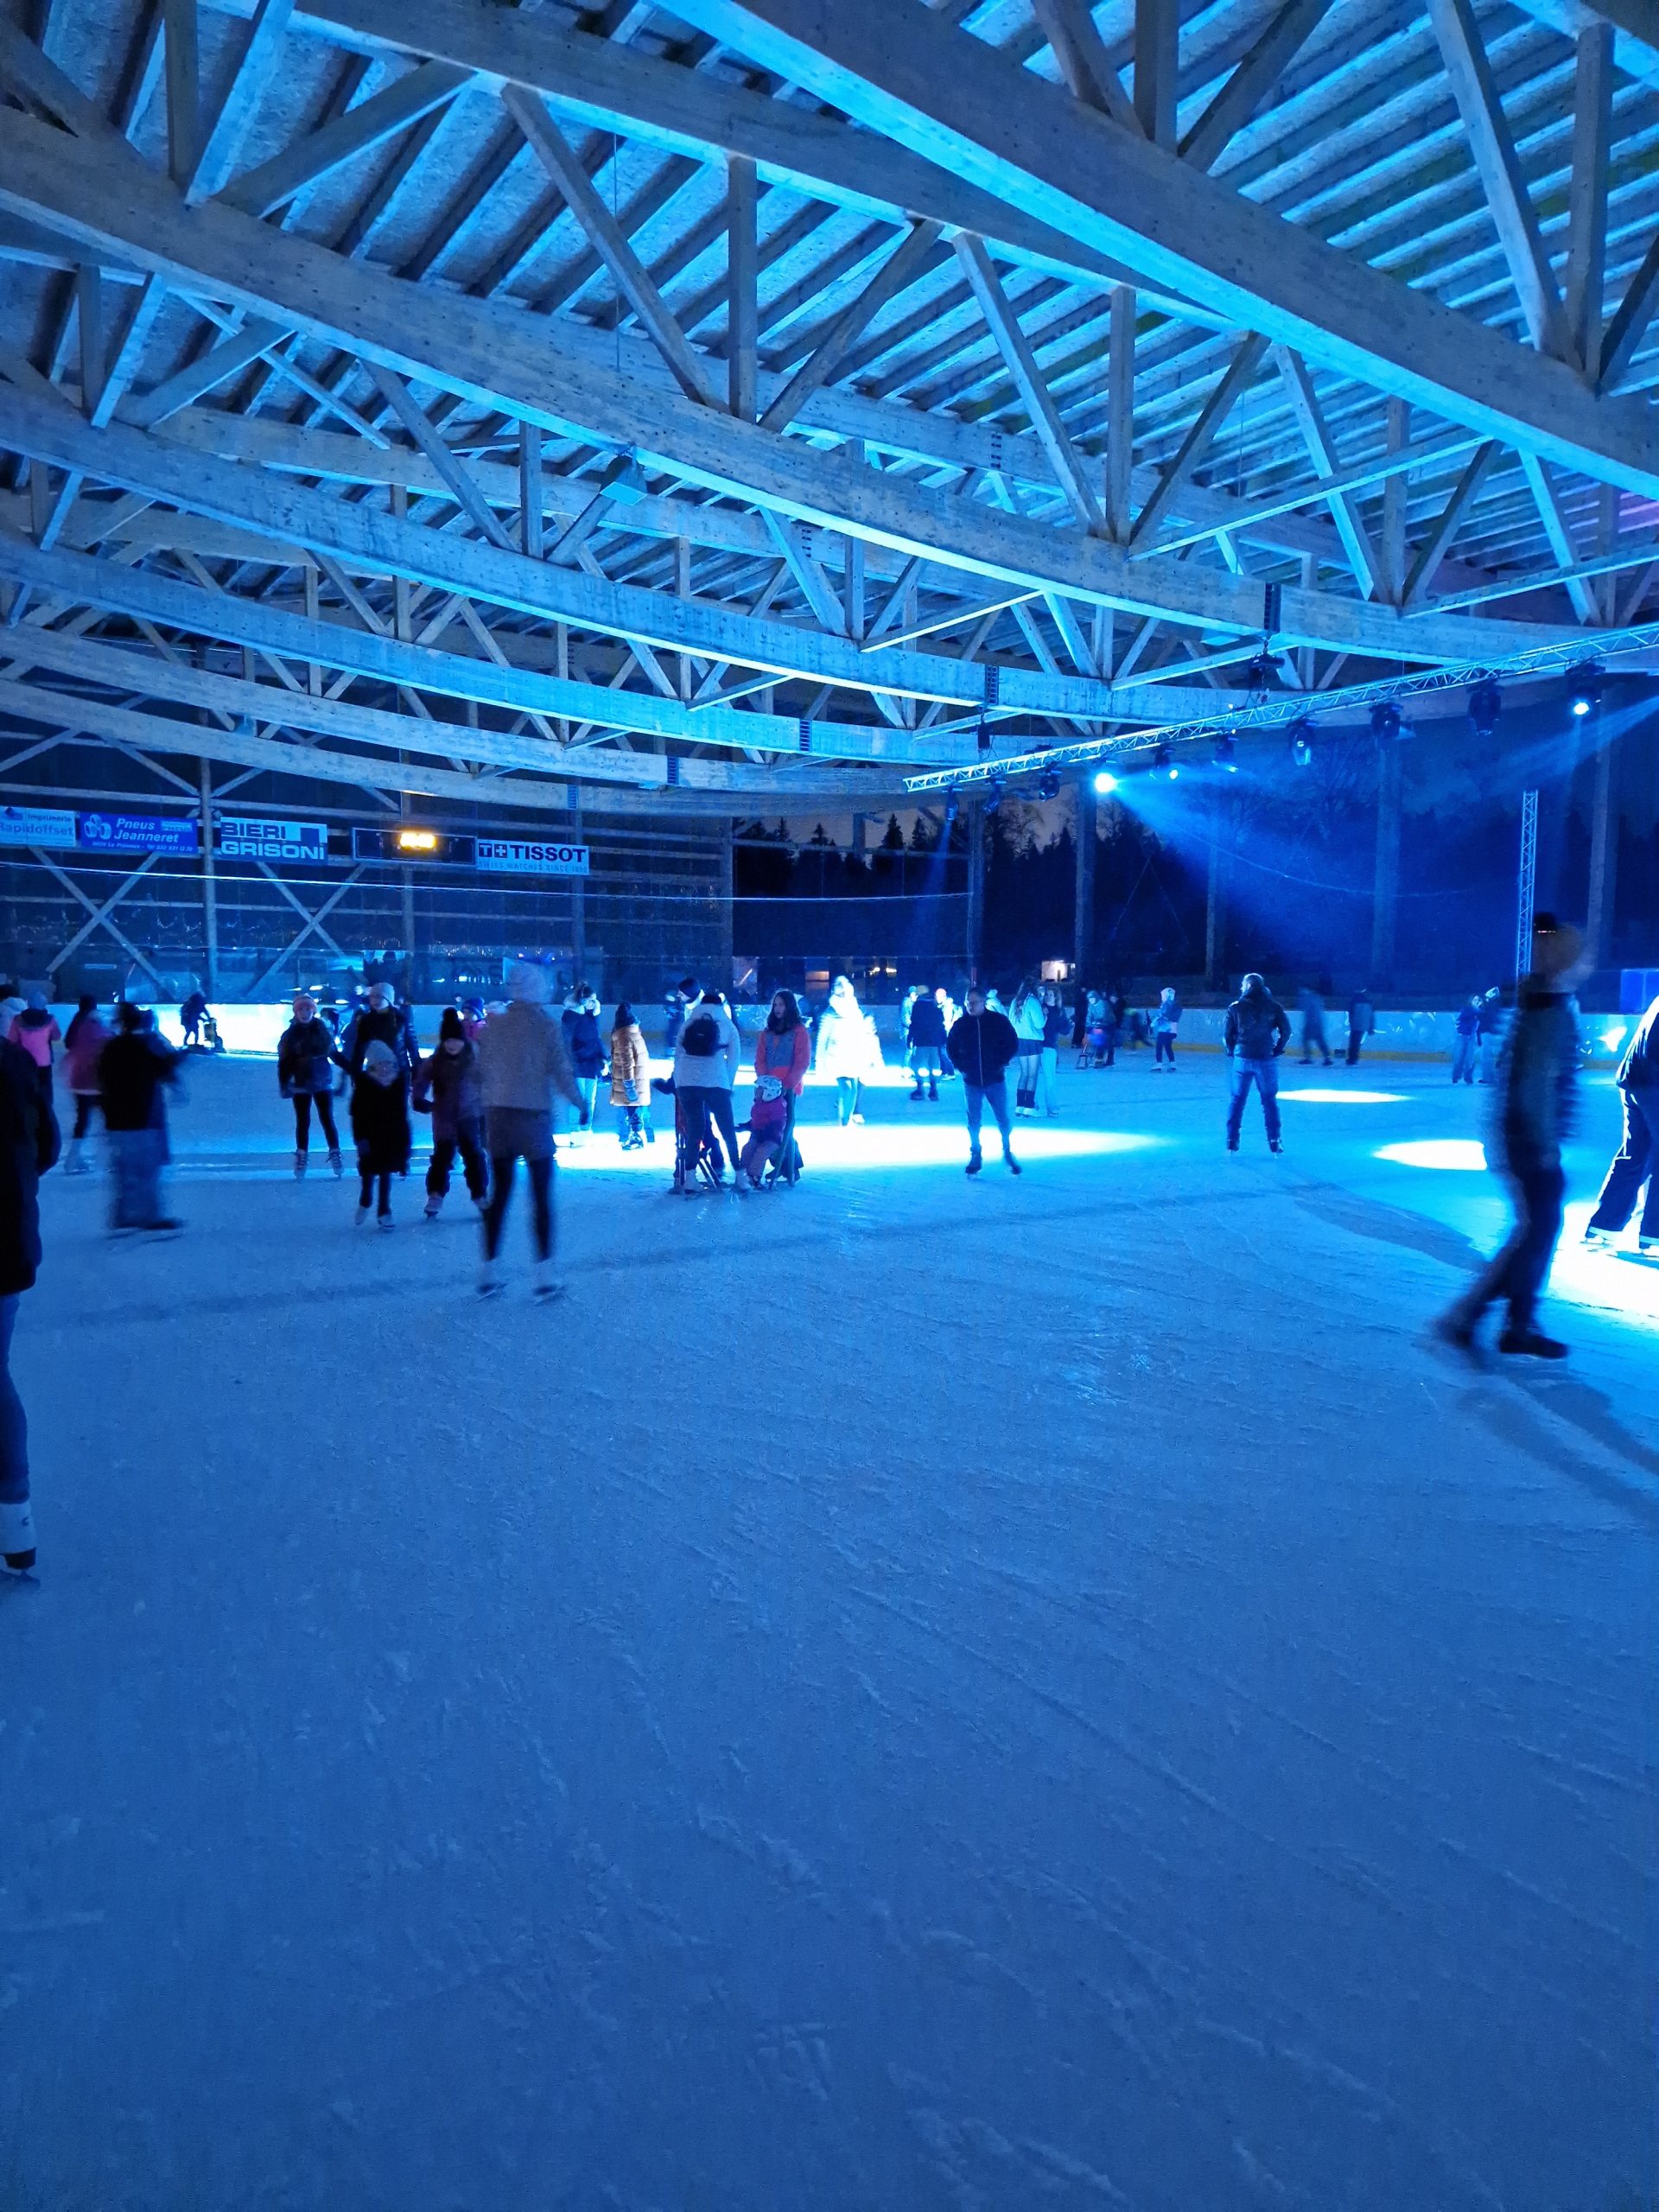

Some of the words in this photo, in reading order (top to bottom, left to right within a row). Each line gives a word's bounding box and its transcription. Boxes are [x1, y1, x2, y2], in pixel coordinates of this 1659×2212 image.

[116, 817, 155, 830] Pneus
[221, 822, 286, 839] BIERI
[114, 830, 179, 843] Jeanneret
[509, 844, 587, 862] TISSOT
